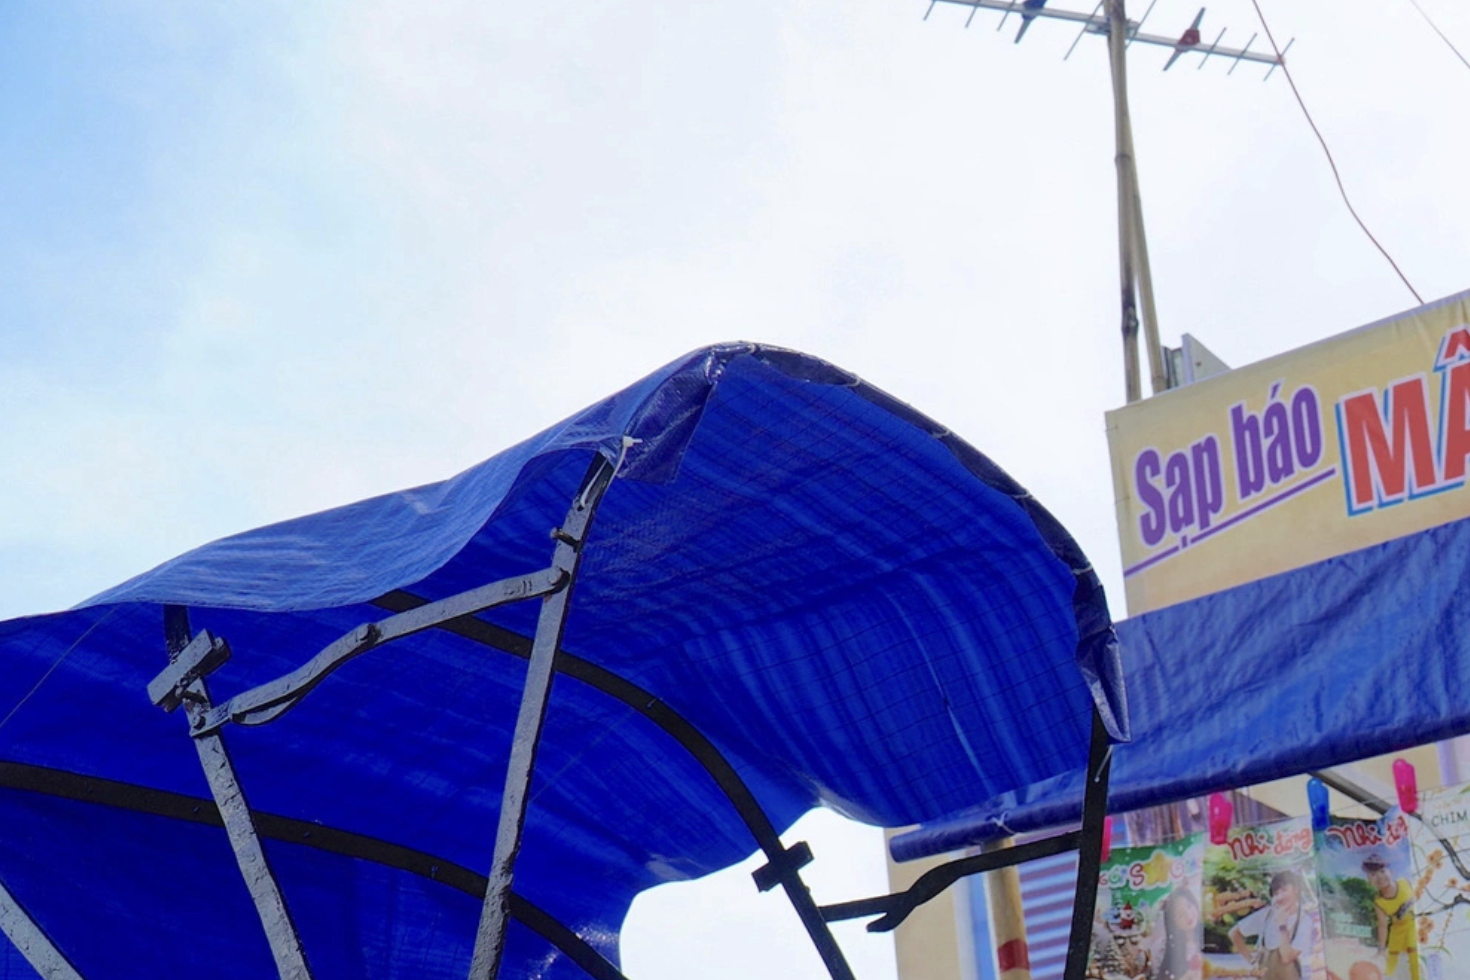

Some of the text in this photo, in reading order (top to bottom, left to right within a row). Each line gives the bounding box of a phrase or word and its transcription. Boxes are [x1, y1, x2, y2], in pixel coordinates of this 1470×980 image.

[1135, 436, 1225, 551] Sạp
[1228, 381, 1323, 501] báo
[1431, 809, 1468, 828] CHIM
